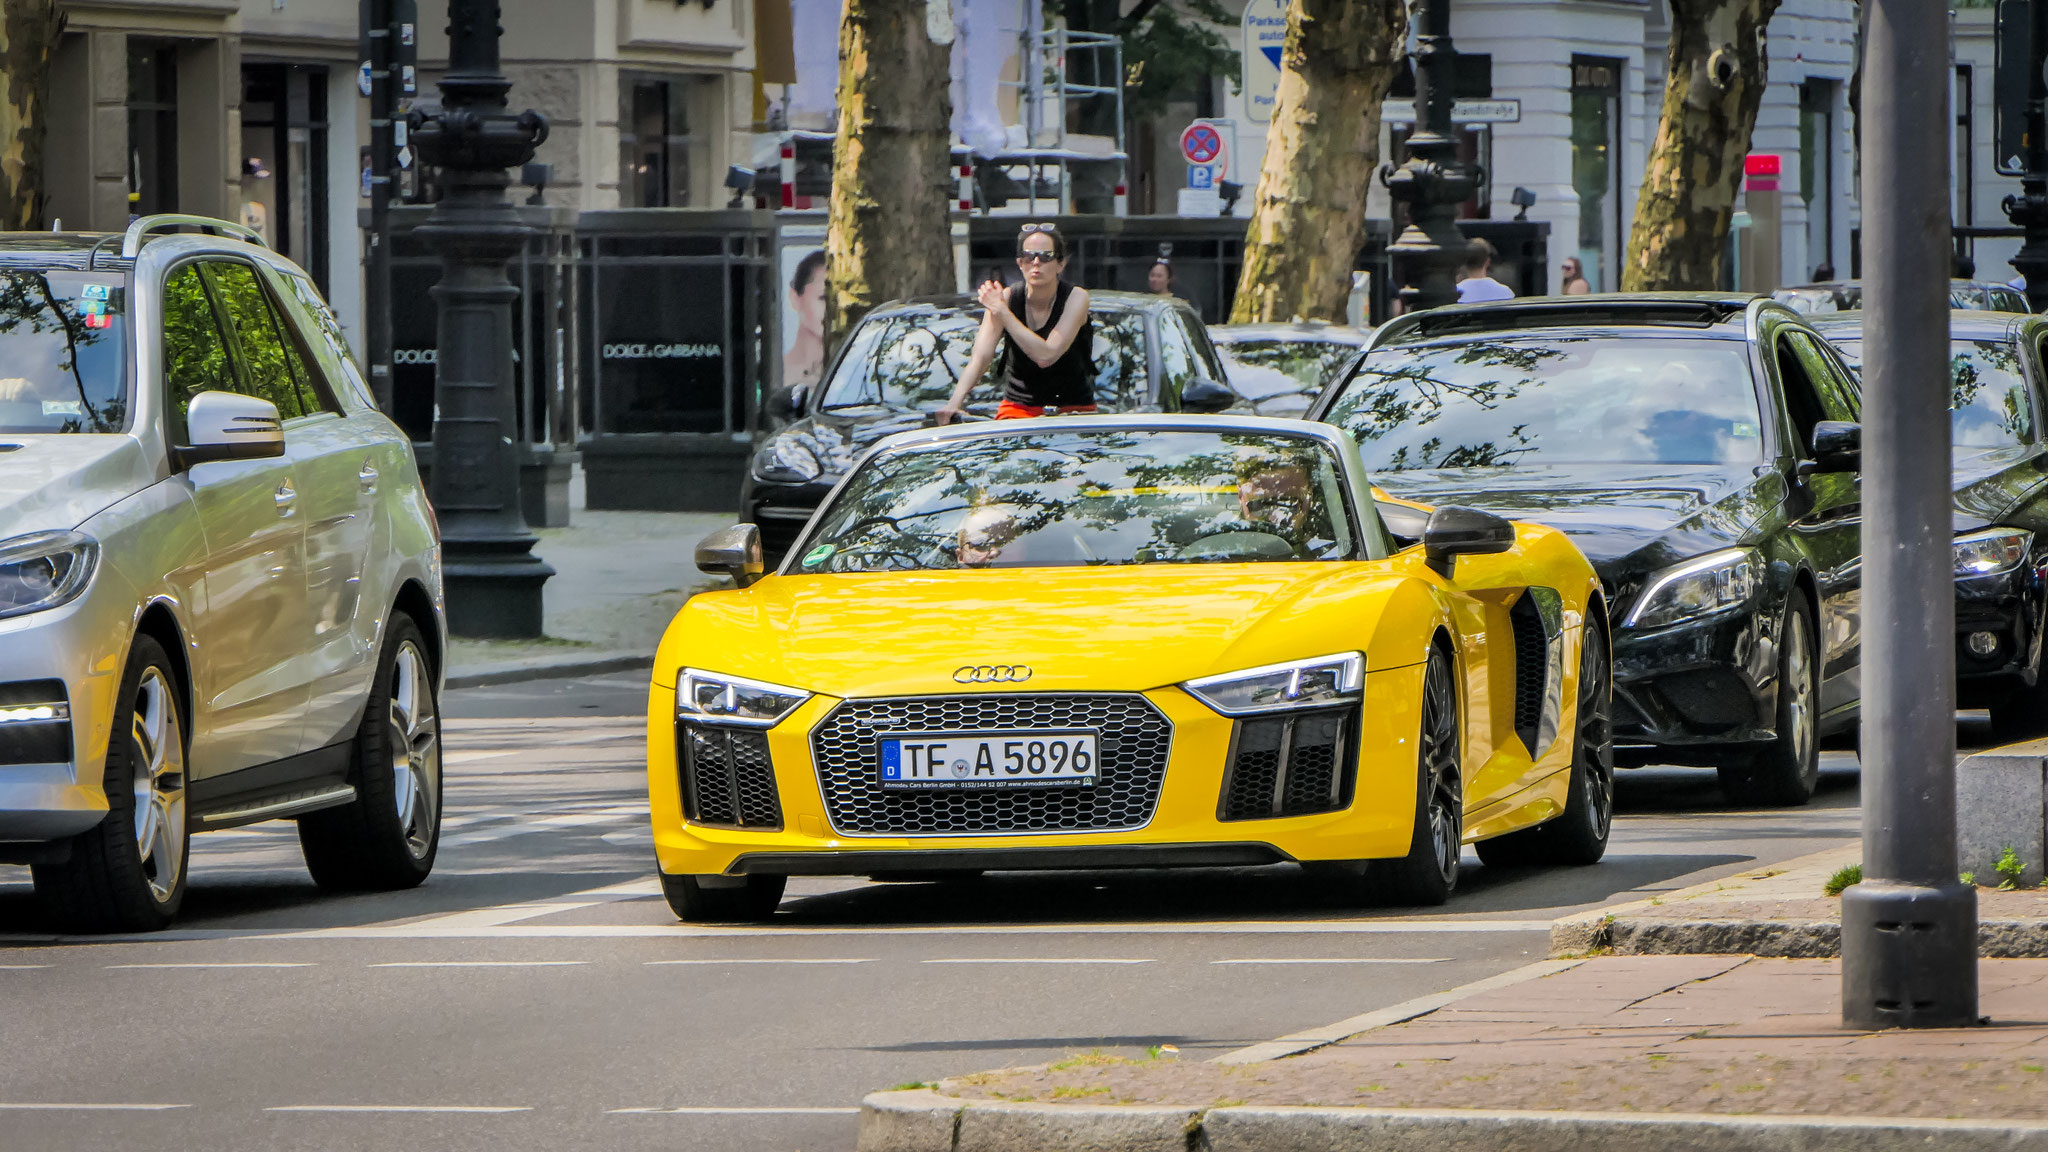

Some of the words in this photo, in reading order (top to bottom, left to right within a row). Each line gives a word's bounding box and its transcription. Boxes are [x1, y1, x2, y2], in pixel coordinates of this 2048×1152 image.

[904, 743, 948, 777] TF
[974, 742, 995, 776] A
[1004, 740, 1091, 775] 5896
[887, 766, 895, 776] D
